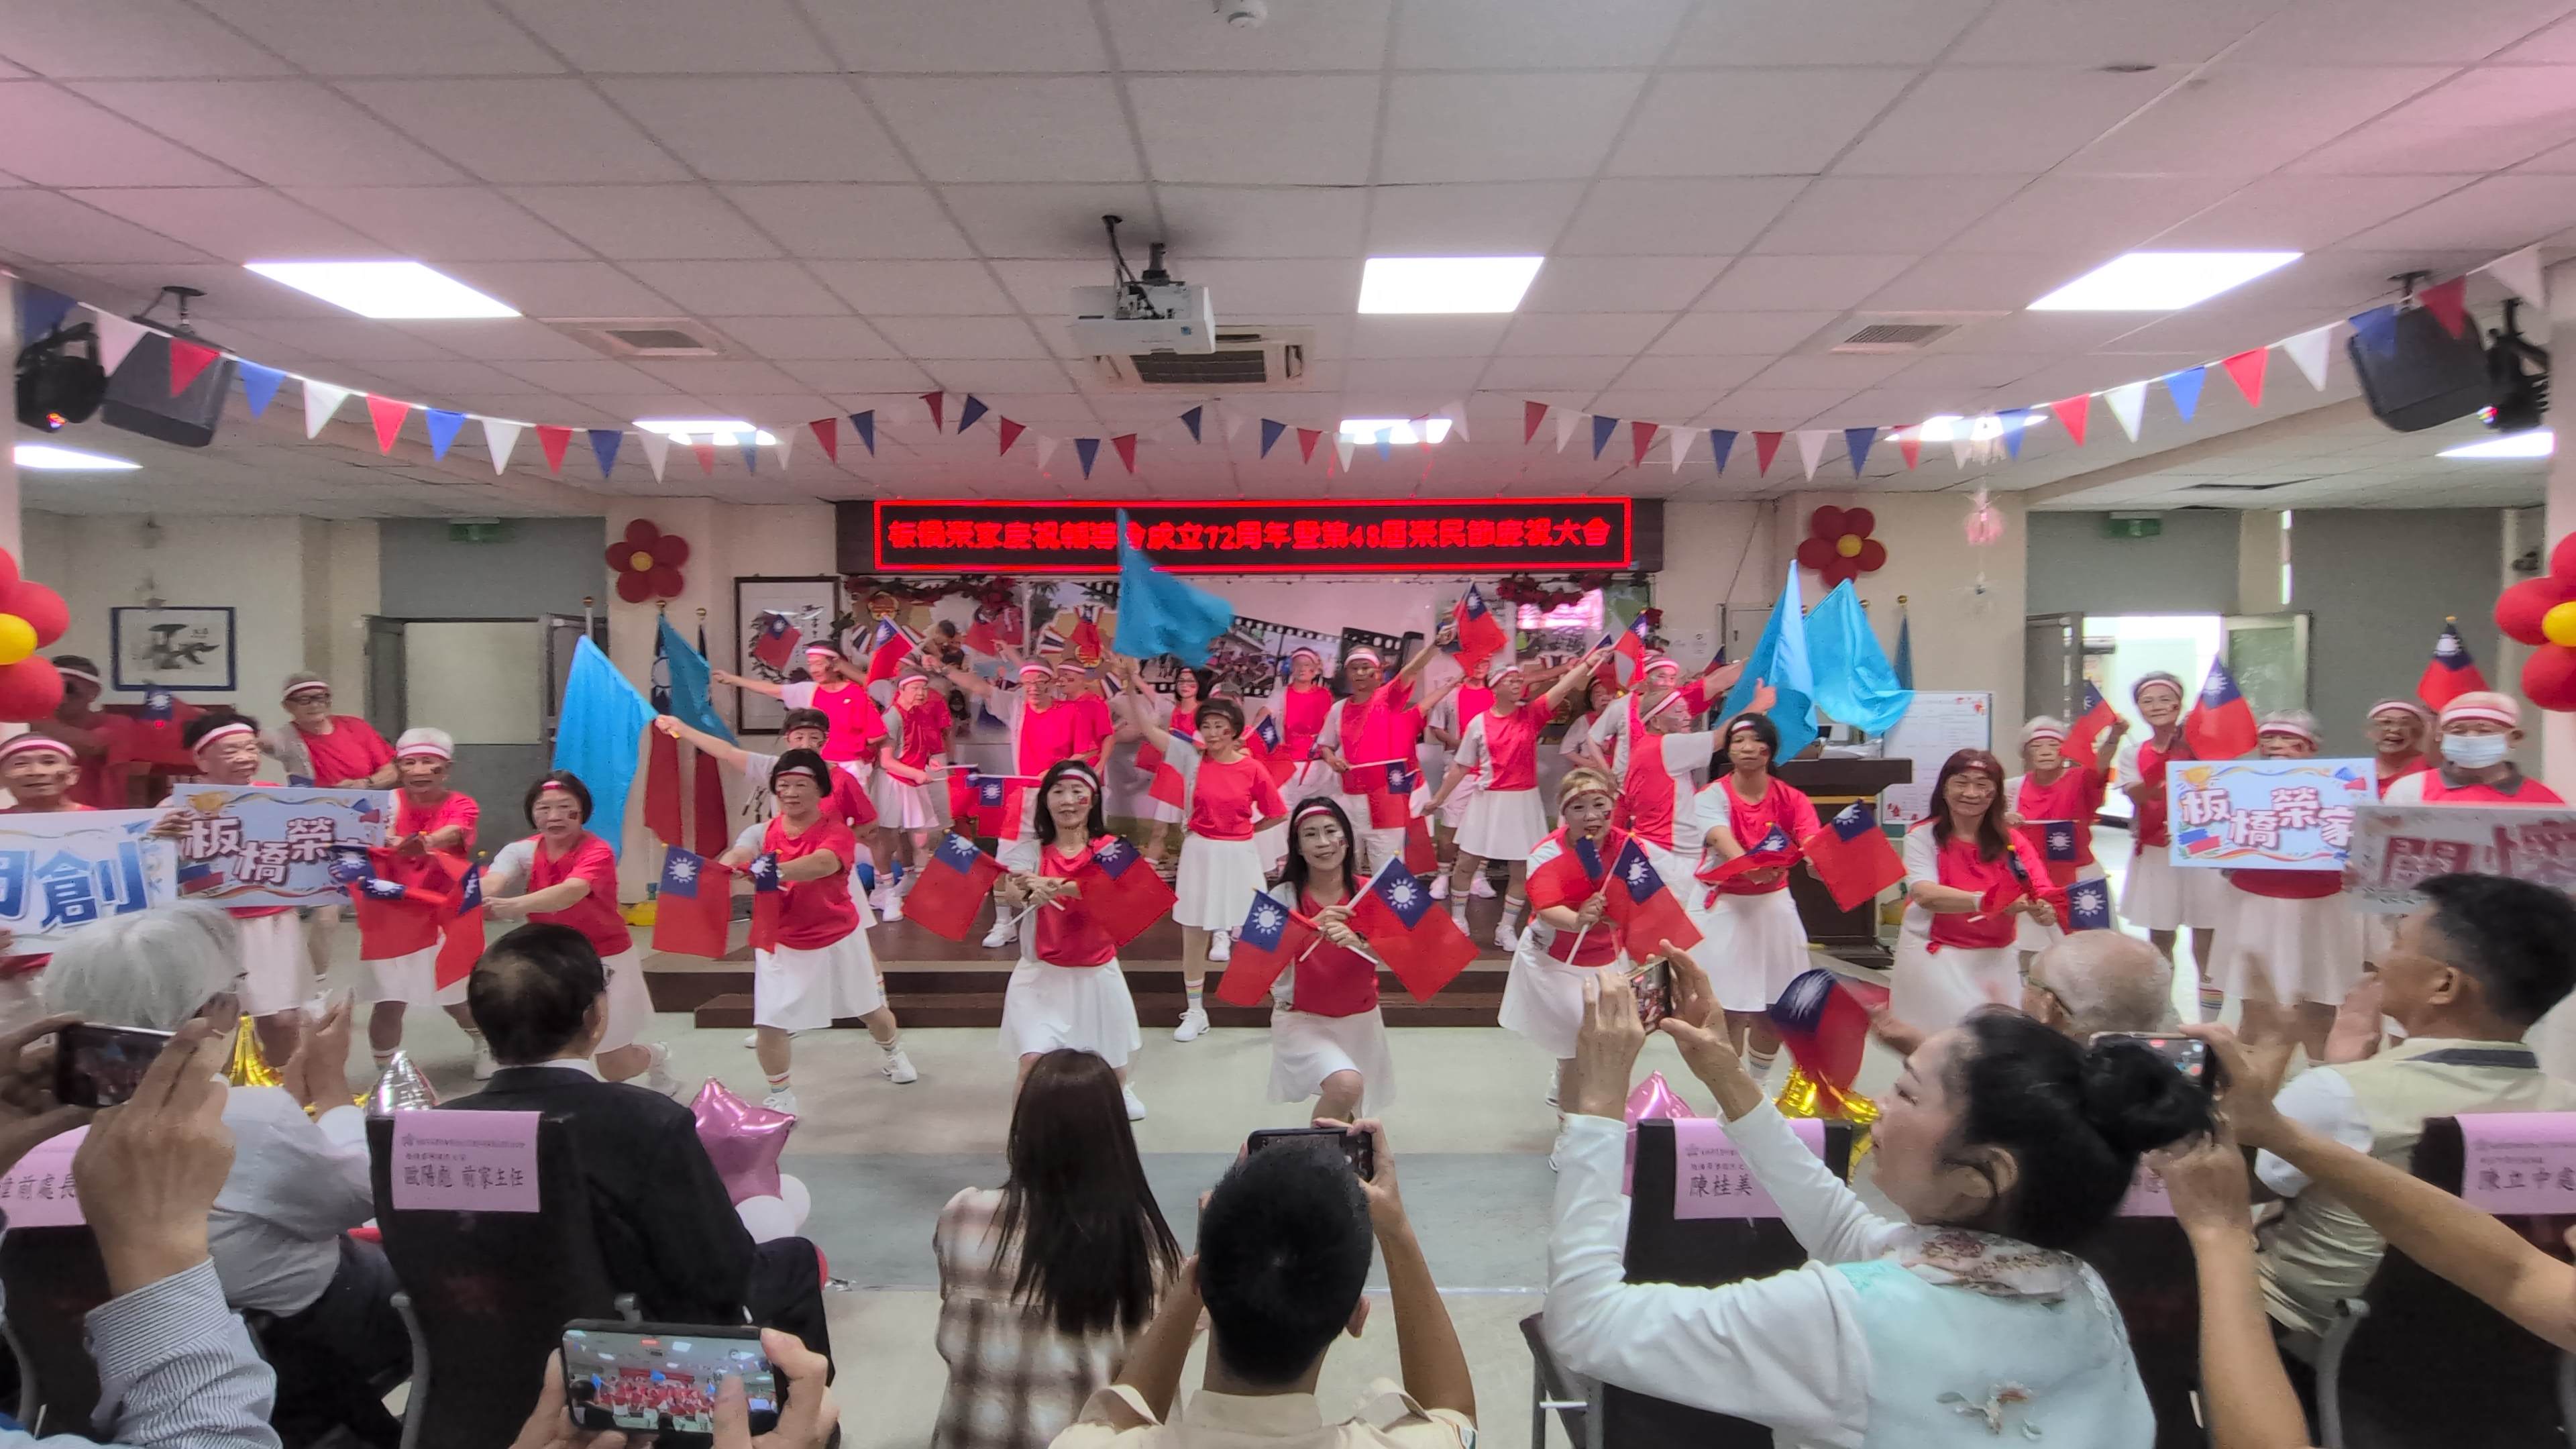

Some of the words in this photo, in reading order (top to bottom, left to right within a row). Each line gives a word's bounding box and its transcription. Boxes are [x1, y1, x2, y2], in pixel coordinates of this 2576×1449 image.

[181, 816, 370, 884] 板橋榮
[2181, 787, 2355, 850] 板橋榮家
[0, 840, 148, 927] 創
